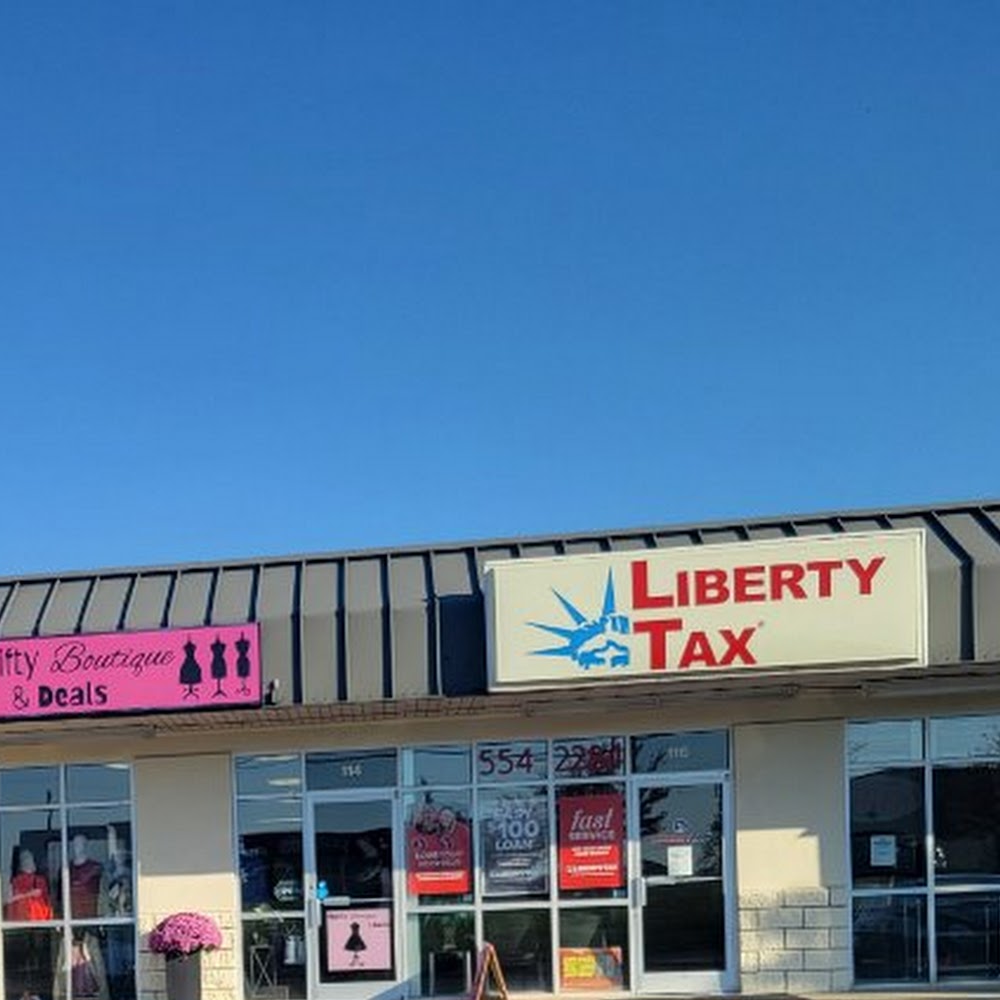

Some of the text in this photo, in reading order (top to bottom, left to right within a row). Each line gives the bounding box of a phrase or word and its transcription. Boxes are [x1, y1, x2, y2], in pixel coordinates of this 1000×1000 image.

[630, 555, 887, 610] LIBERTY
[51, 641, 175, 677] Boutique
[633, 617, 758, 670] TAX
[12, 682, 109, 710] & Deals
[479, 748, 533, 776] 554
